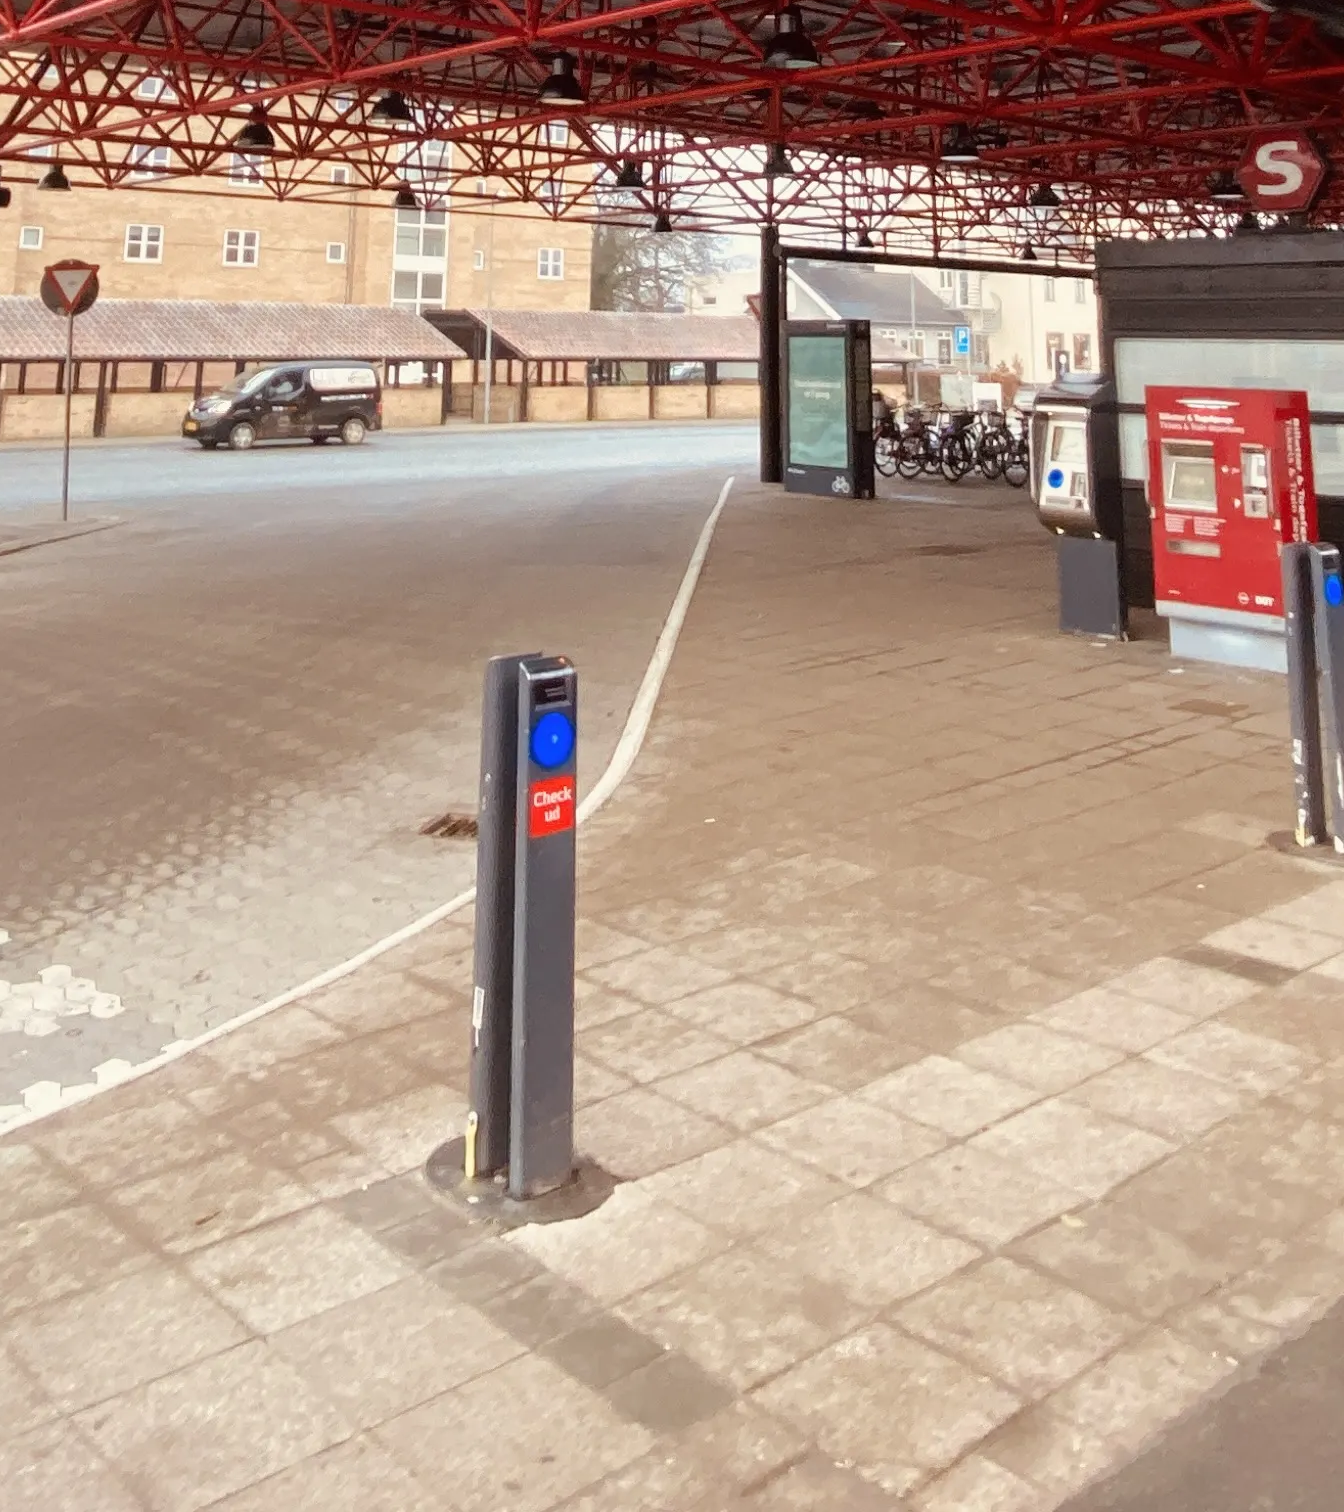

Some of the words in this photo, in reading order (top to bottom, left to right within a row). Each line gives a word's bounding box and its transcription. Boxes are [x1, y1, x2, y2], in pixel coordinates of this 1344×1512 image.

[1255, 140, 1304, 196] S
[958, 330, 966, 343] P
[533, 786, 572, 807] Check
[544, 805, 561, 822] ud
